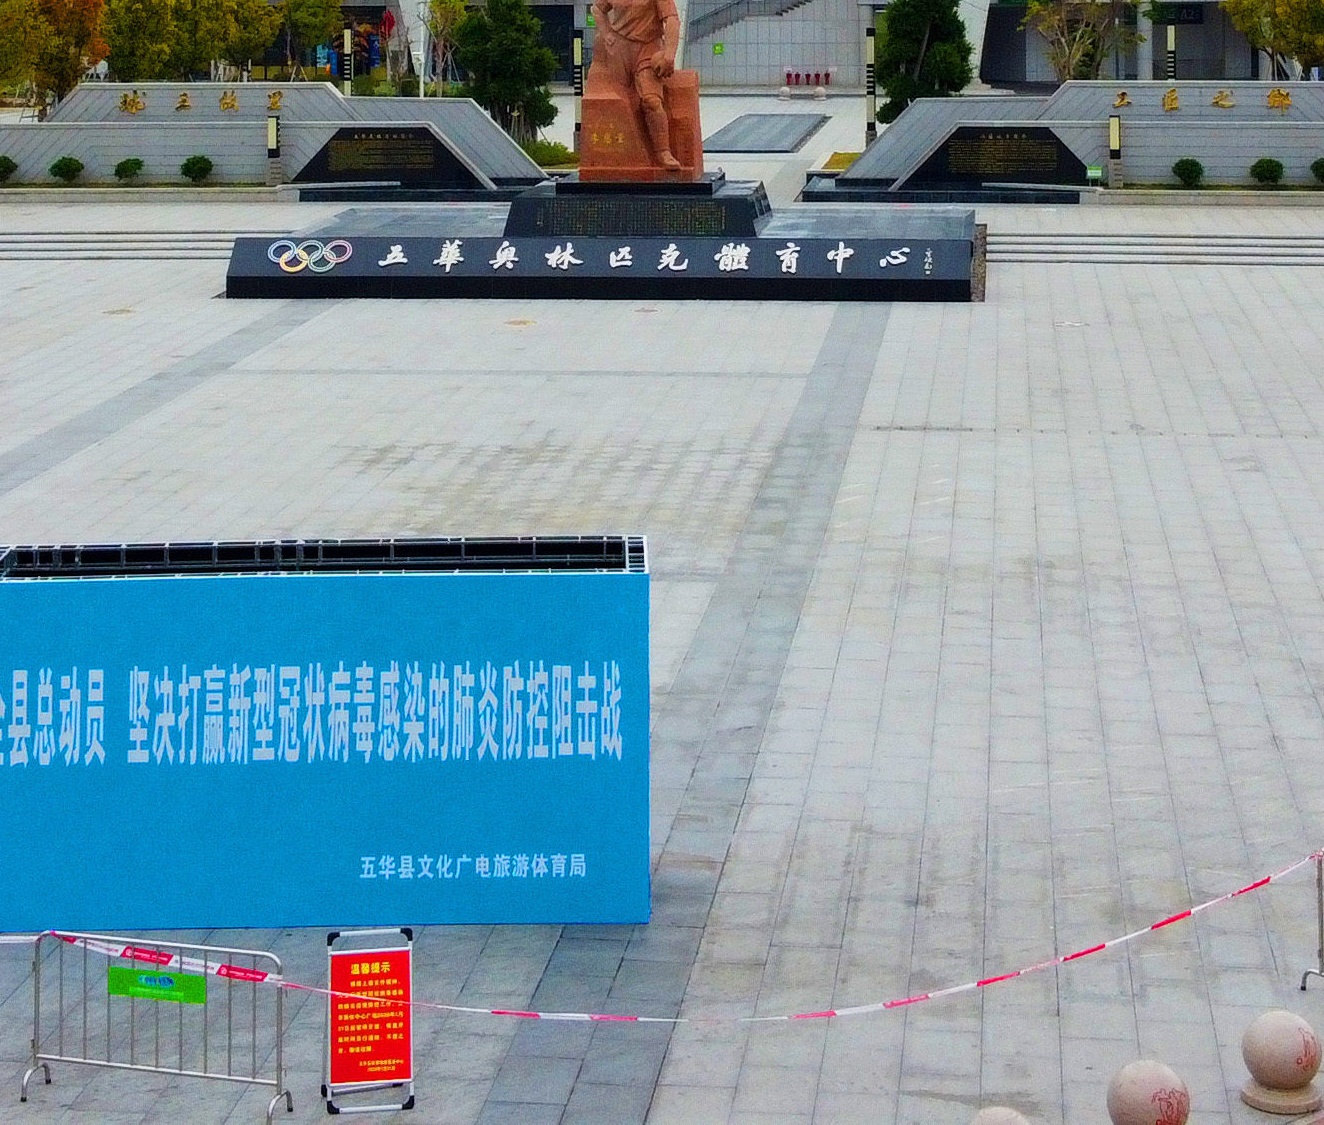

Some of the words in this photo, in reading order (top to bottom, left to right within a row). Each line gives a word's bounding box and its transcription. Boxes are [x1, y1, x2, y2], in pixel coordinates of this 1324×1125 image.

[127, 659, 624, 766] 坚决打赢新型冠状病毒感染的肺炎防控阻击战
[359, 852, 588, 881] 五华县文化广电旅游体育局
